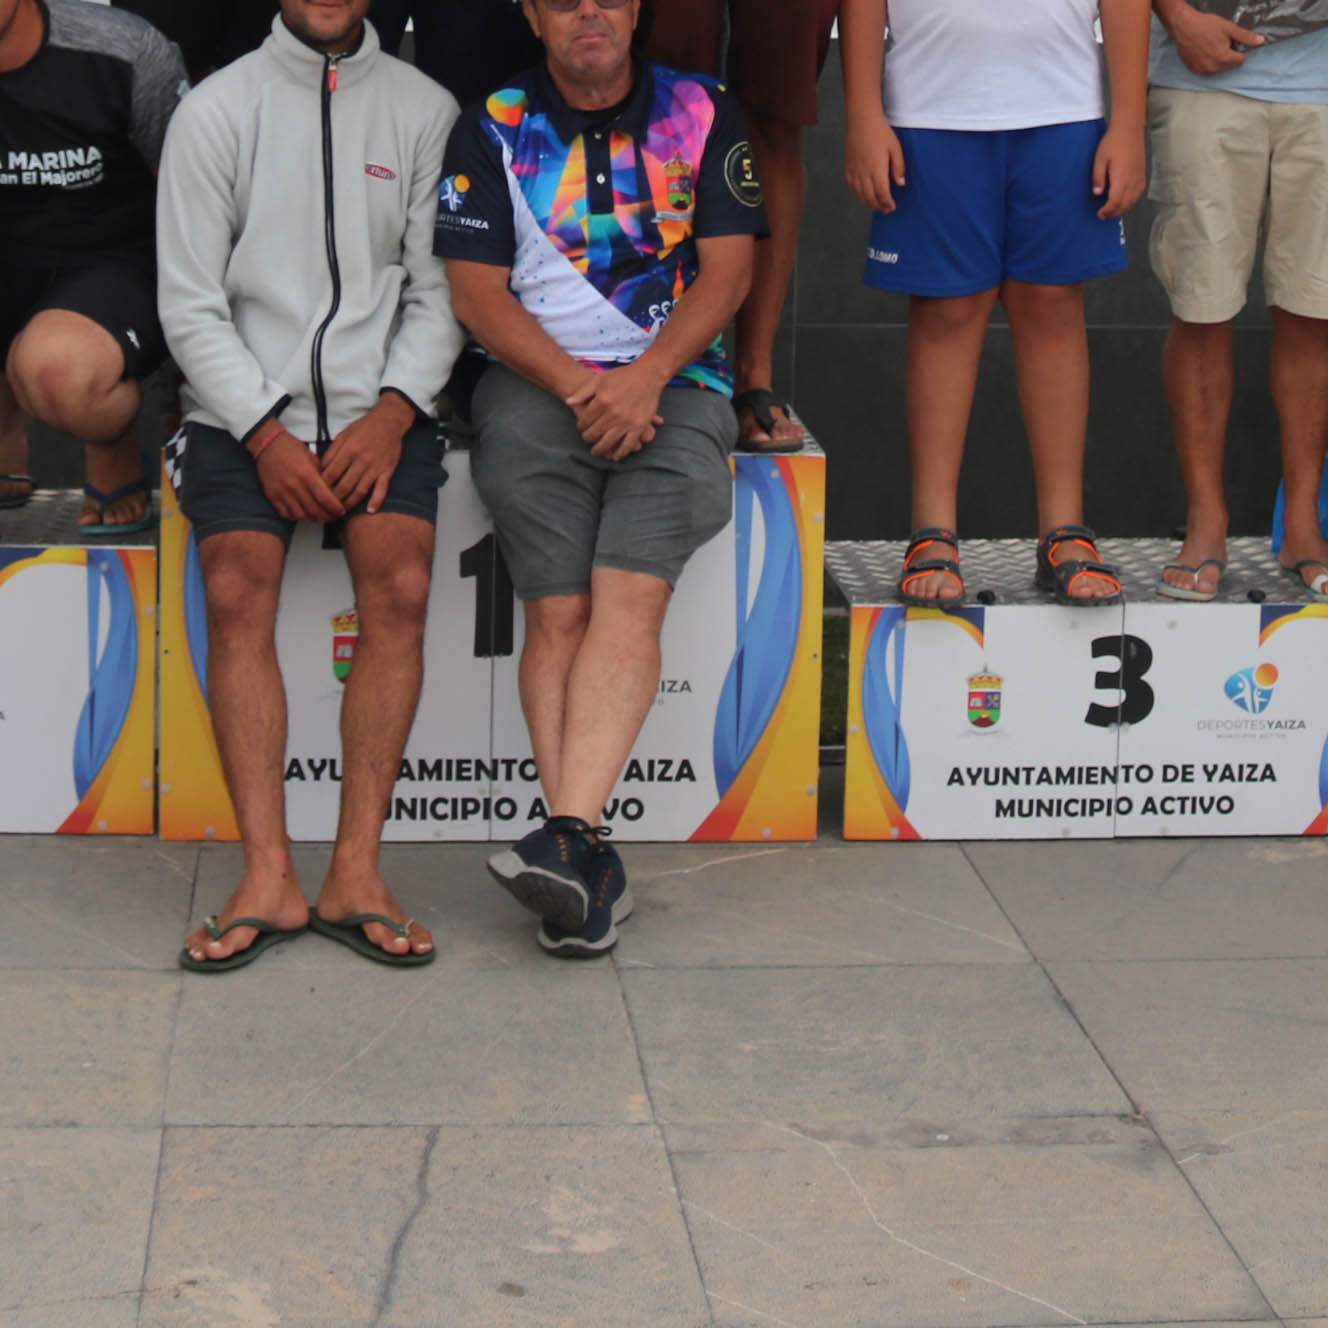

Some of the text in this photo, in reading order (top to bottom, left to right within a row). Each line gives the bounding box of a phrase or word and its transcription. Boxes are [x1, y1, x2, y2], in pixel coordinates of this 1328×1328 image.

[8, 146, 103, 171] MARINA
[23, 171, 37, 185] El
[459, 533, 514, 658] 1
[1084, 633, 1155, 729] 3
[285, 758, 696, 782] AYUAMIENTO AIZA
[947, 762, 1277, 786] AYUNTAMIENTO DE YAIZA
[384, 797, 518, 821] NICIPIO
[995, 795, 1235, 818] MUNICIPIO ACTIVO
